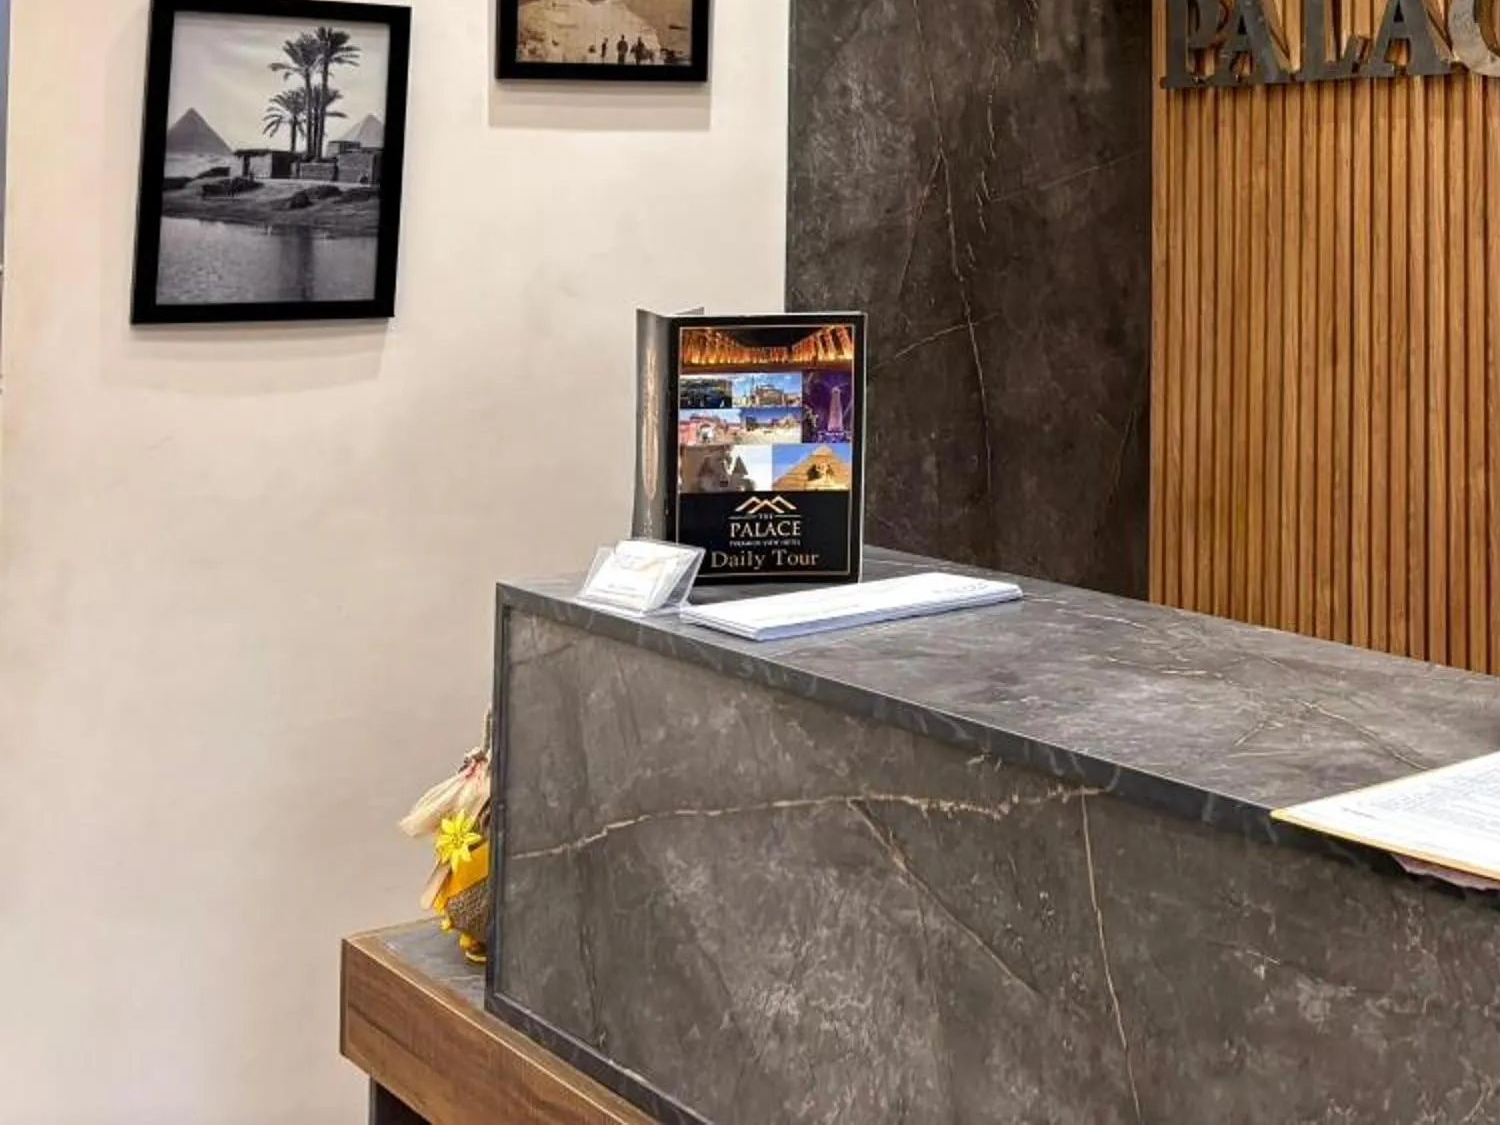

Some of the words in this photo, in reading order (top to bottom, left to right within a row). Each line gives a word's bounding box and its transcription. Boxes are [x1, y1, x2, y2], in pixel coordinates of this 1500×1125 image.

[730, 520, 802, 538] PALACE
[711, 550, 766, 570] Daily
[772, 549, 820, 567] Tour
